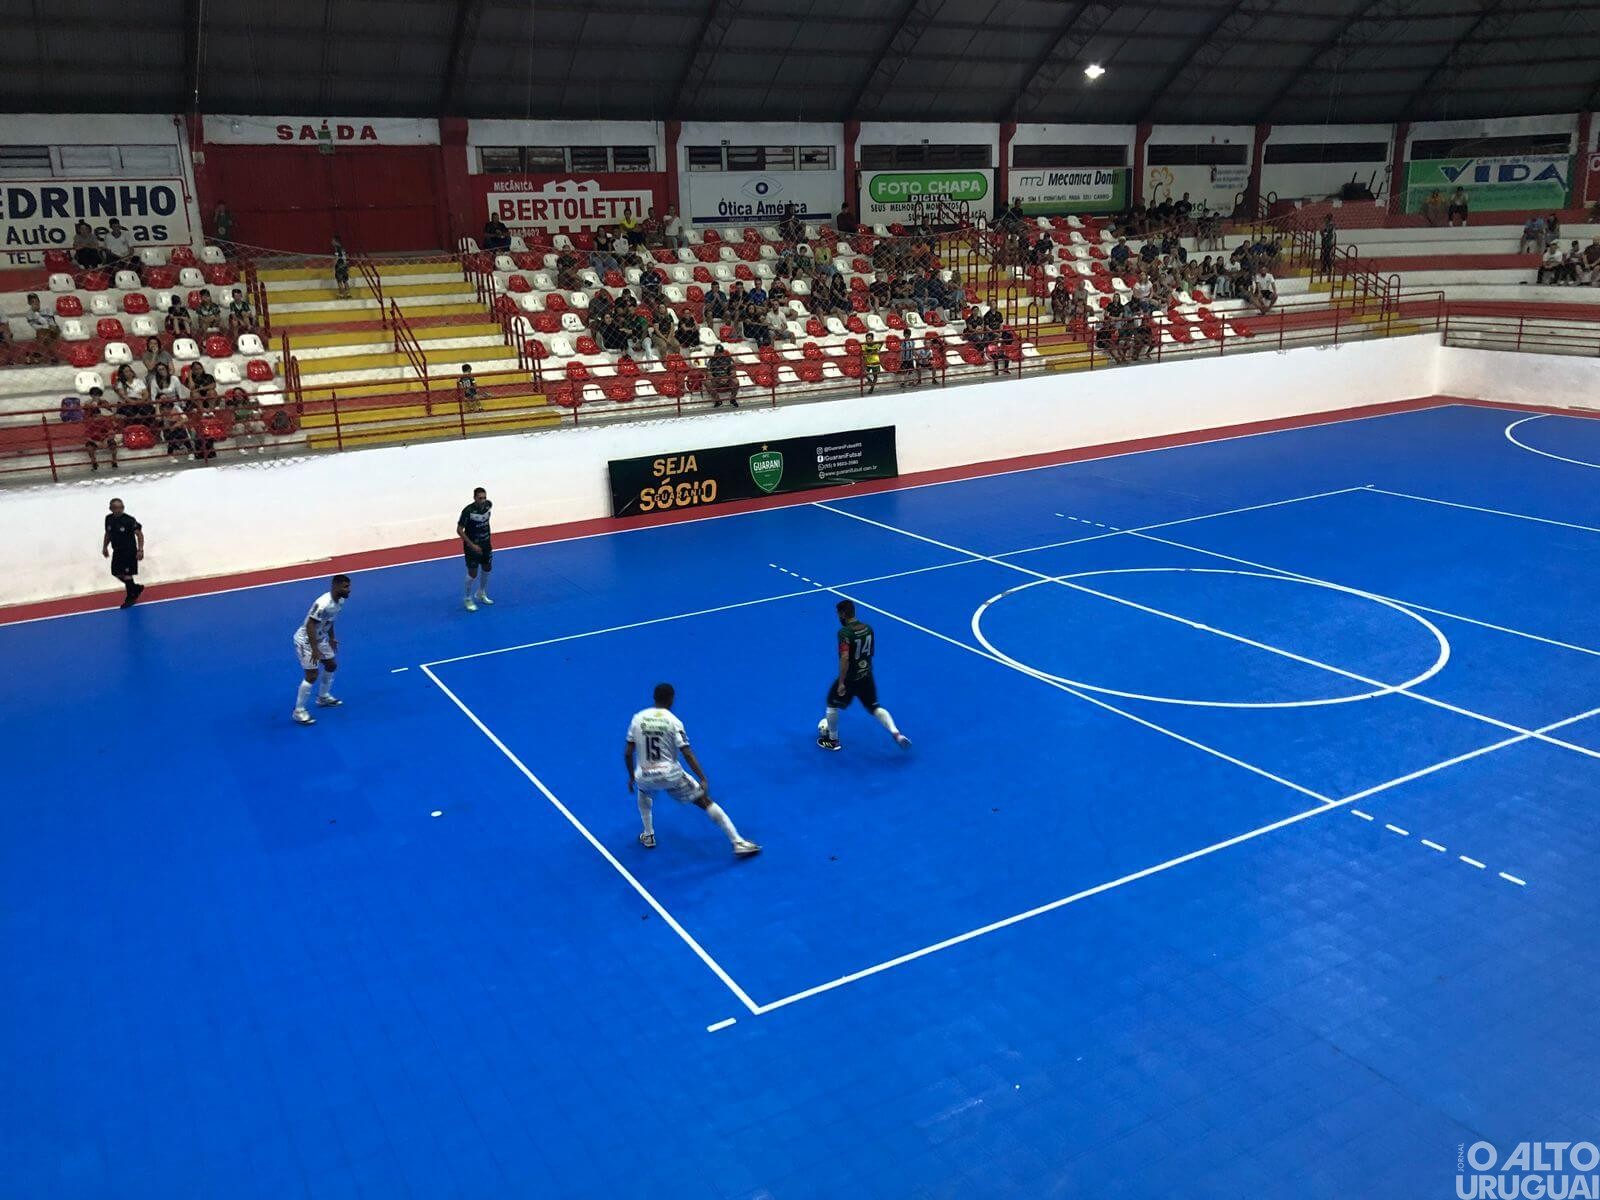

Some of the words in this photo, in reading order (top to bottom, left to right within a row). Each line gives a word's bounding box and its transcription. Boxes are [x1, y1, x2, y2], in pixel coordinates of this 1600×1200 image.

[1440, 159, 1568, 191] VIDA
[494, 179, 534, 193] MECÂNICA
[878, 181, 922, 195] FOTO
[928, 180, 981, 194] CHAPA
[0, 186, 176, 219] DRINHO
[718, 198, 752, 216] Ótica
[911, 193, 952, 202] DIGITAL
[498, 197, 642, 221] BERTOLETTI
[870, 204, 886, 212] SEUS
[6, 224, 66, 245] Auto
[7, 252, 41, 264] TEL.
[653, 455, 698, 477] SEJA
[753, 459, 781, 471] GUARANI
[639, 477, 717, 511] SÓCIO
[654, 488, 701, 502] GUARANI
[854, 635, 872, 660] 14
[645, 736, 661, 761] 15
